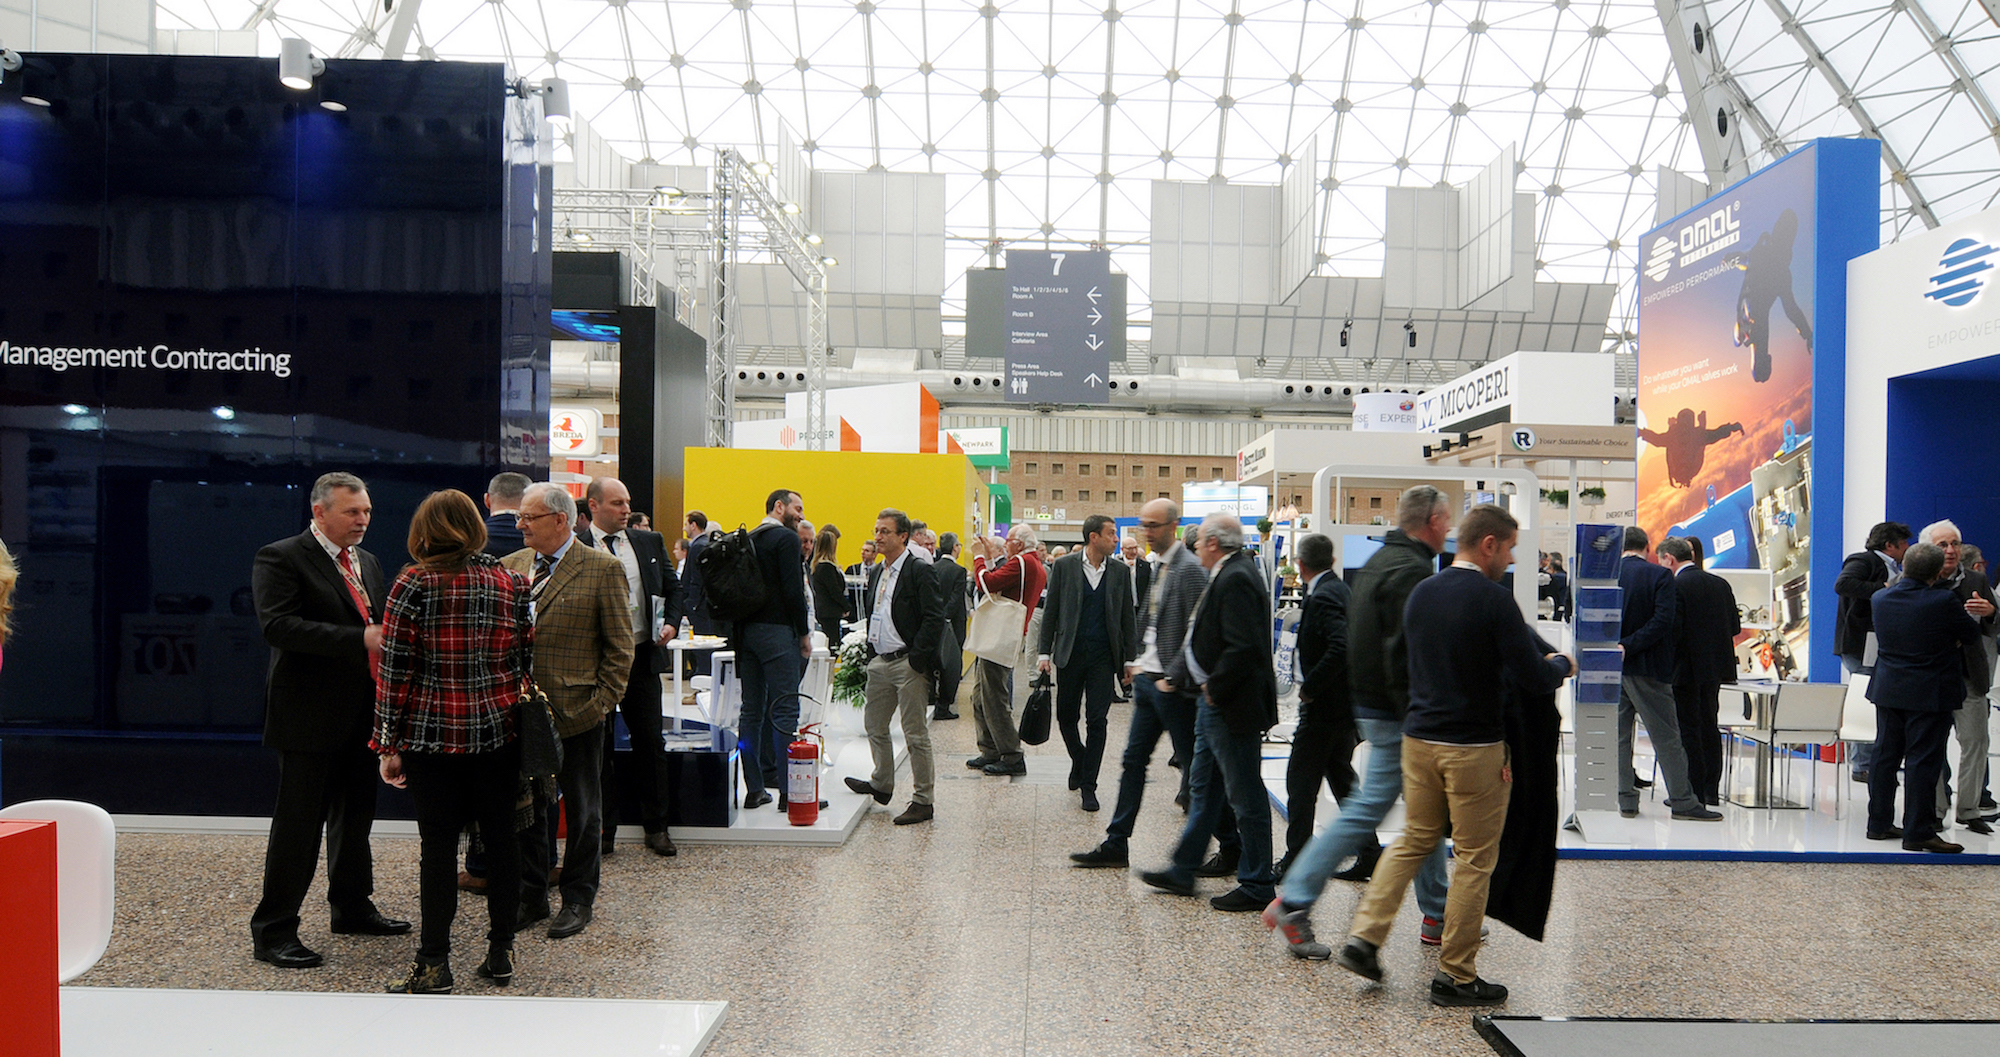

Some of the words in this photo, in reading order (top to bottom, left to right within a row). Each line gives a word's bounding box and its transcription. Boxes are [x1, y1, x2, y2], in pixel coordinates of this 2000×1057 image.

[1051, 253, 1066, 276] 7
[1644, 281, 1684, 306] EMPOWERED
[1686, 256, 1740, 287] PERFORMANCE
[151, 344, 291, 377] Contracting
[1643, 375, 1652, 385] Do
[1653, 367, 1680, 382] whatever
[1680, 364, 1692, 377] you
[1693, 358, 1710, 371] want
[1440, 367, 1509, 420] MICOPERI
[1652, 383, 1667, 395] while
[1668, 380, 1682, 394] your
[1682, 374, 1701, 388] OMAL
[1701, 370, 1721, 382] valves
[1721, 363, 1738, 377] work
[1516, 432, 1530, 446] R
[1539, 437, 1556, 445] Your
[1558, 437, 1601, 445] Sustainable
